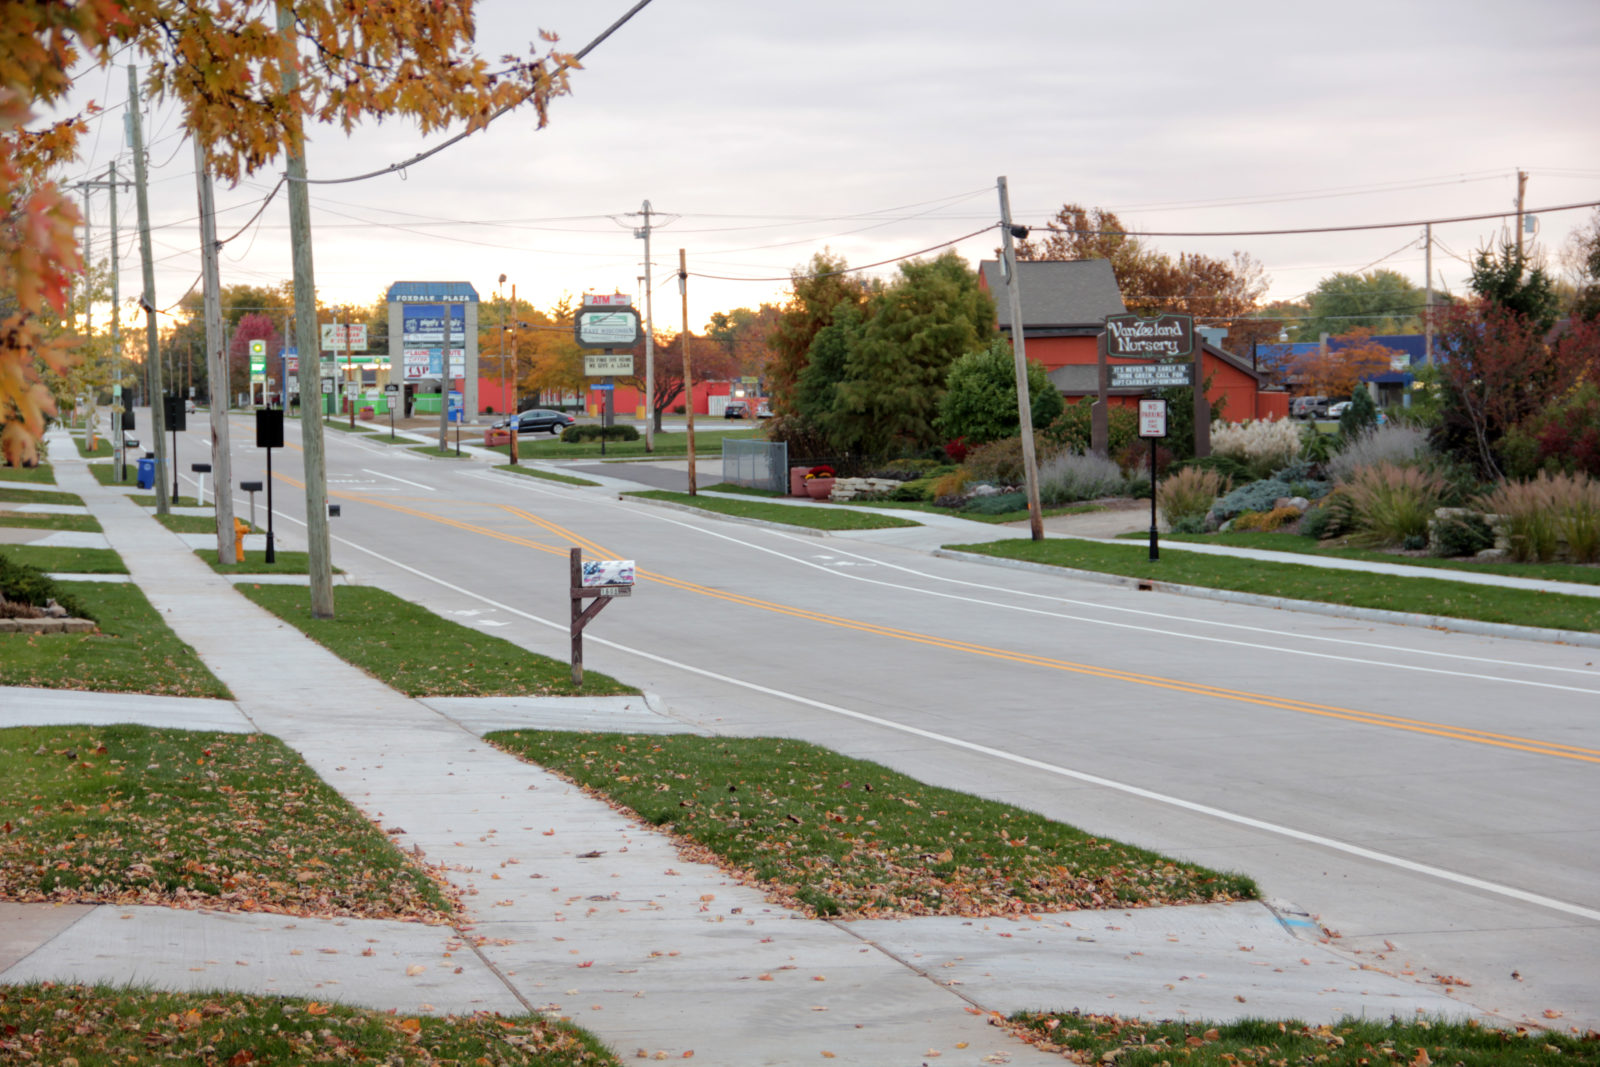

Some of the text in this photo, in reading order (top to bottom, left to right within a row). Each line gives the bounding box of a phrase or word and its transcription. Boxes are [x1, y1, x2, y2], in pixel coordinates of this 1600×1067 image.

[592, 295, 610, 304] ATM
[1107, 321, 1183, 338] VanZeeland
[1118, 337, 1179, 355] Nursery
